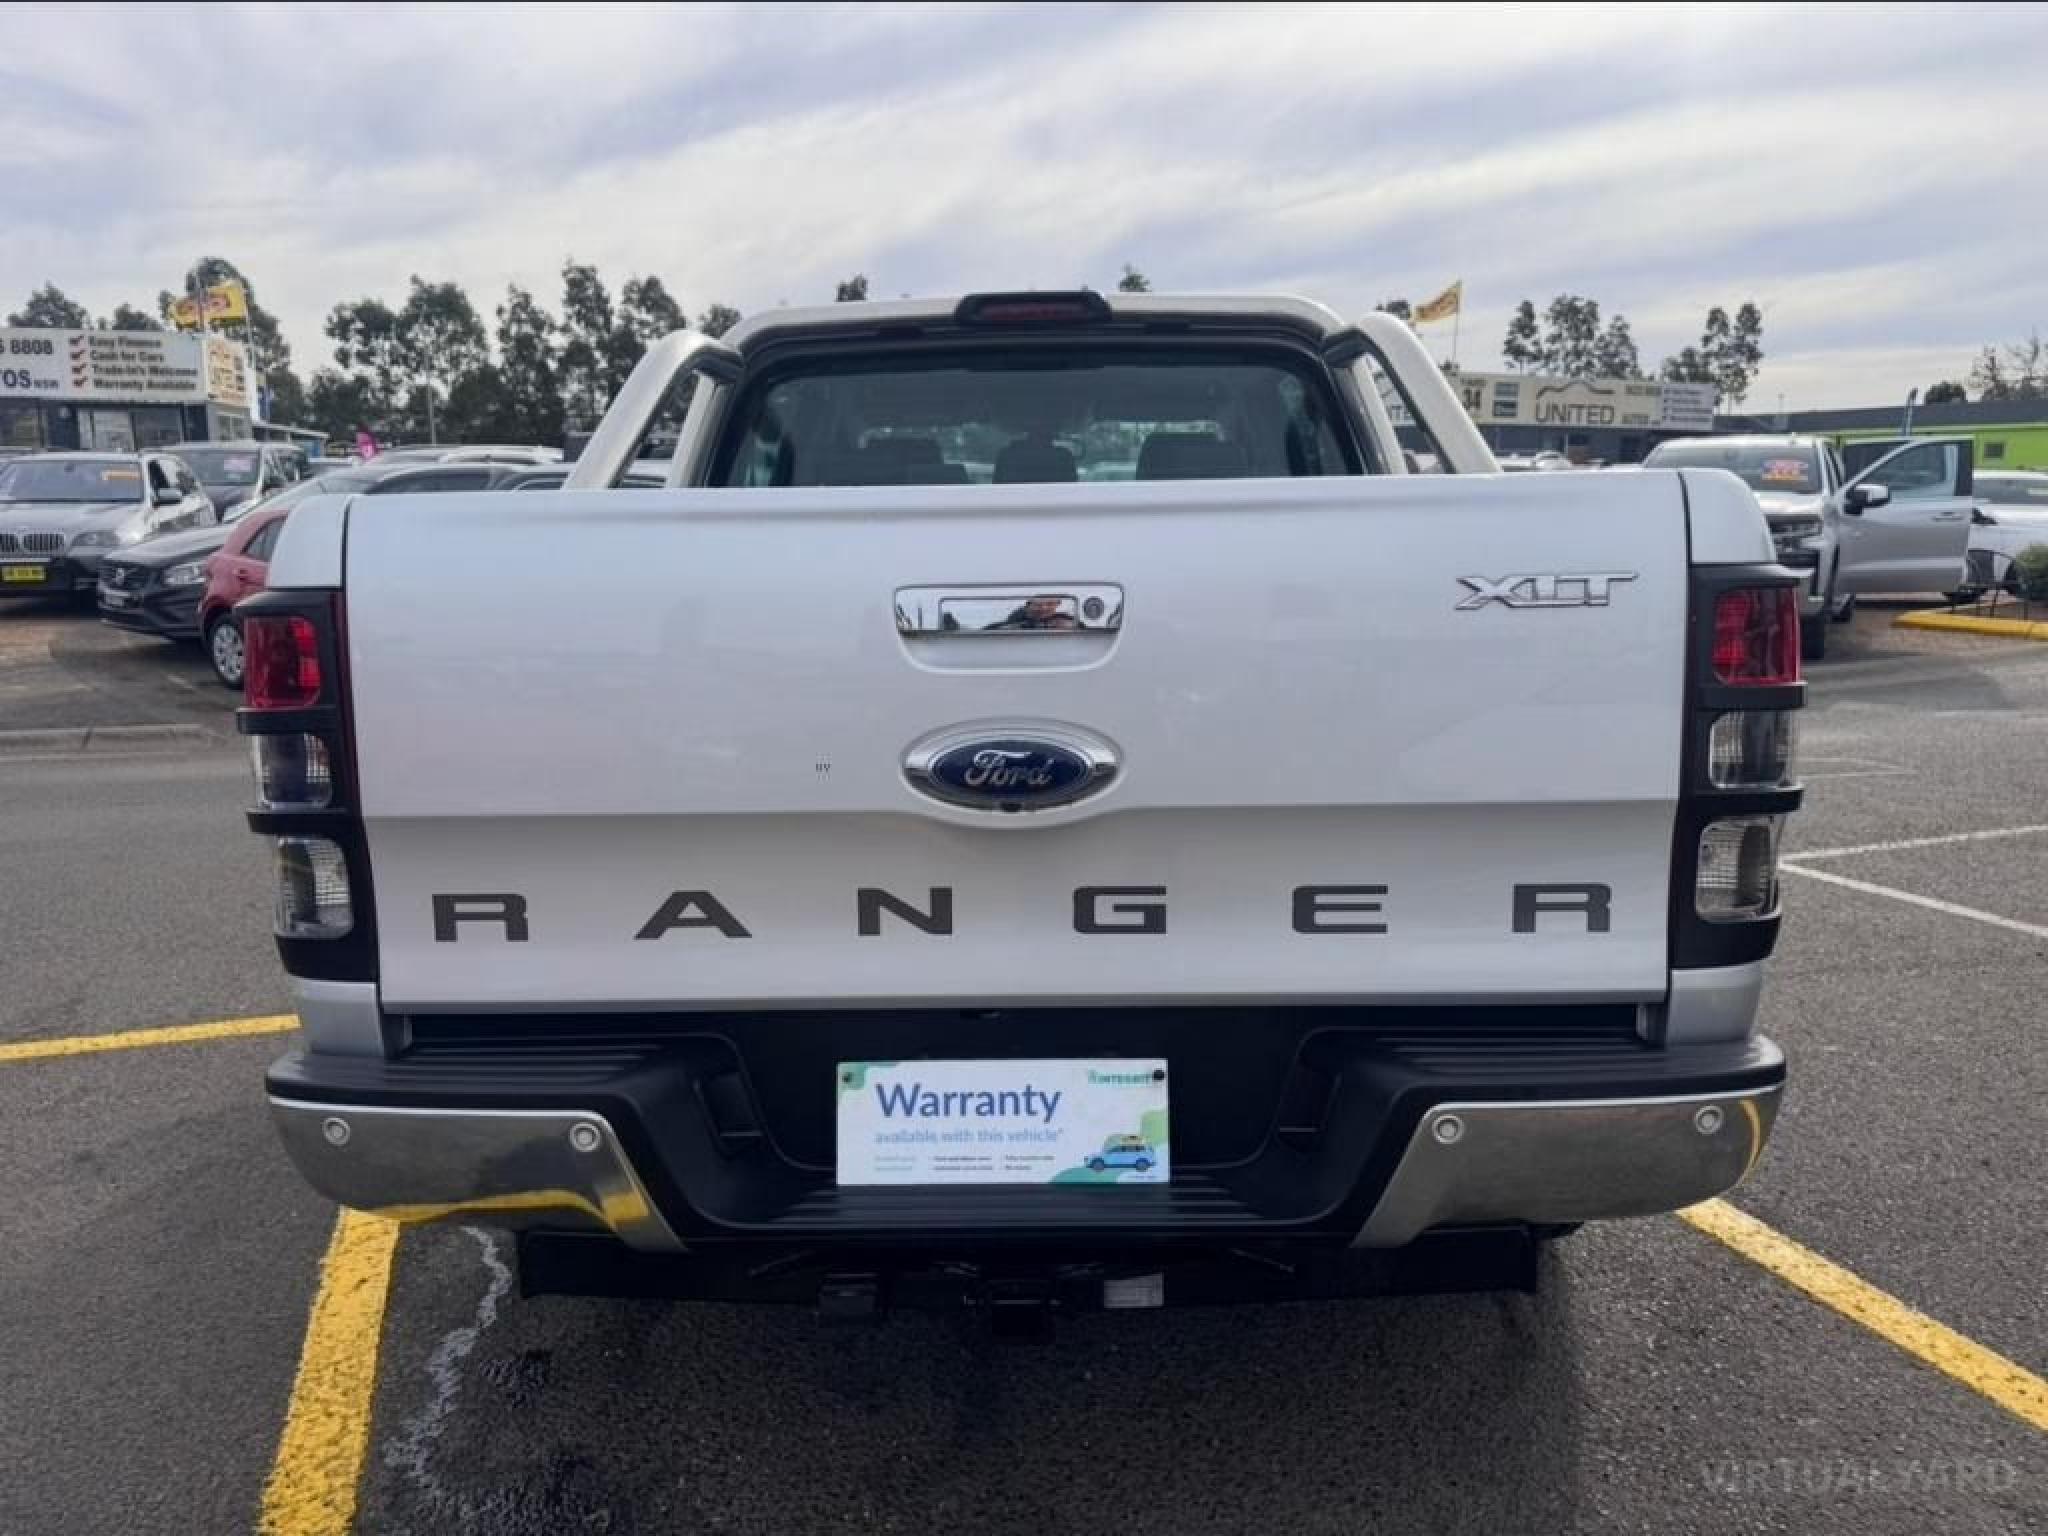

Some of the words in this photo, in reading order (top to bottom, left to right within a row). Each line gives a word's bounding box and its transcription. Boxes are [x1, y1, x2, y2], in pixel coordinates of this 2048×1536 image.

[1535, 403, 1615, 424] UNITED
[1454, 572, 1640, 611] XLT
[963, 750, 1056, 786] Ford
[432, 882, 1612, 943] RANGER
[875, 1083, 1061, 1123] Warranty
